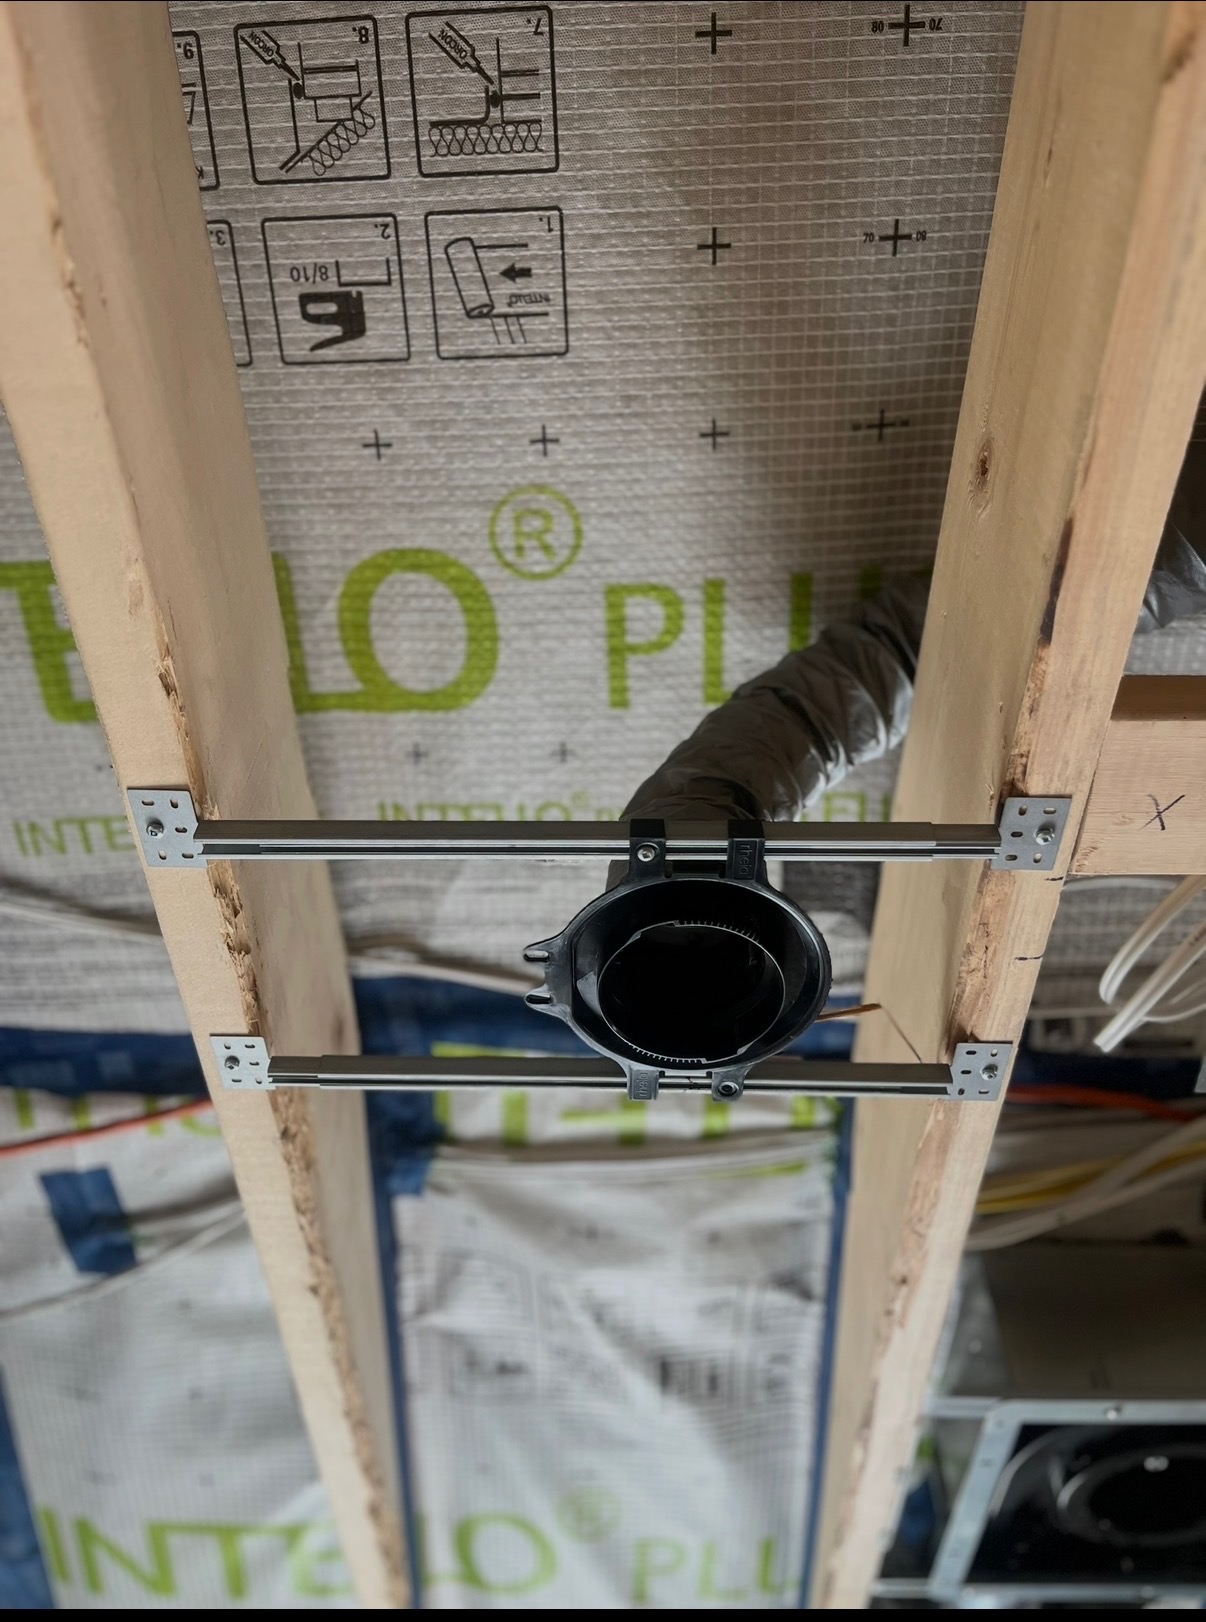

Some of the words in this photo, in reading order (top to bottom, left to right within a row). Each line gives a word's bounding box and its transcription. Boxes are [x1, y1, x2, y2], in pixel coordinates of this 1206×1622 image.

[525, 16, 544, 37] 7.
[928, 18, 943, 31] 70
[247, 29, 275, 58] ORCON
[351, 25, 370, 45] 8.
[437, 28, 467, 59] ORCON
[176, 41, 195, 60] 9.
[373, 221, 391, 240] 2.
[538, 215, 554, 234] 1.
[209, 229, 226, 246] 3.
[863, 233, 875, 244] 70
[289, 265, 330, 285] 8/10
[13, 815, 139, 857] INTE
